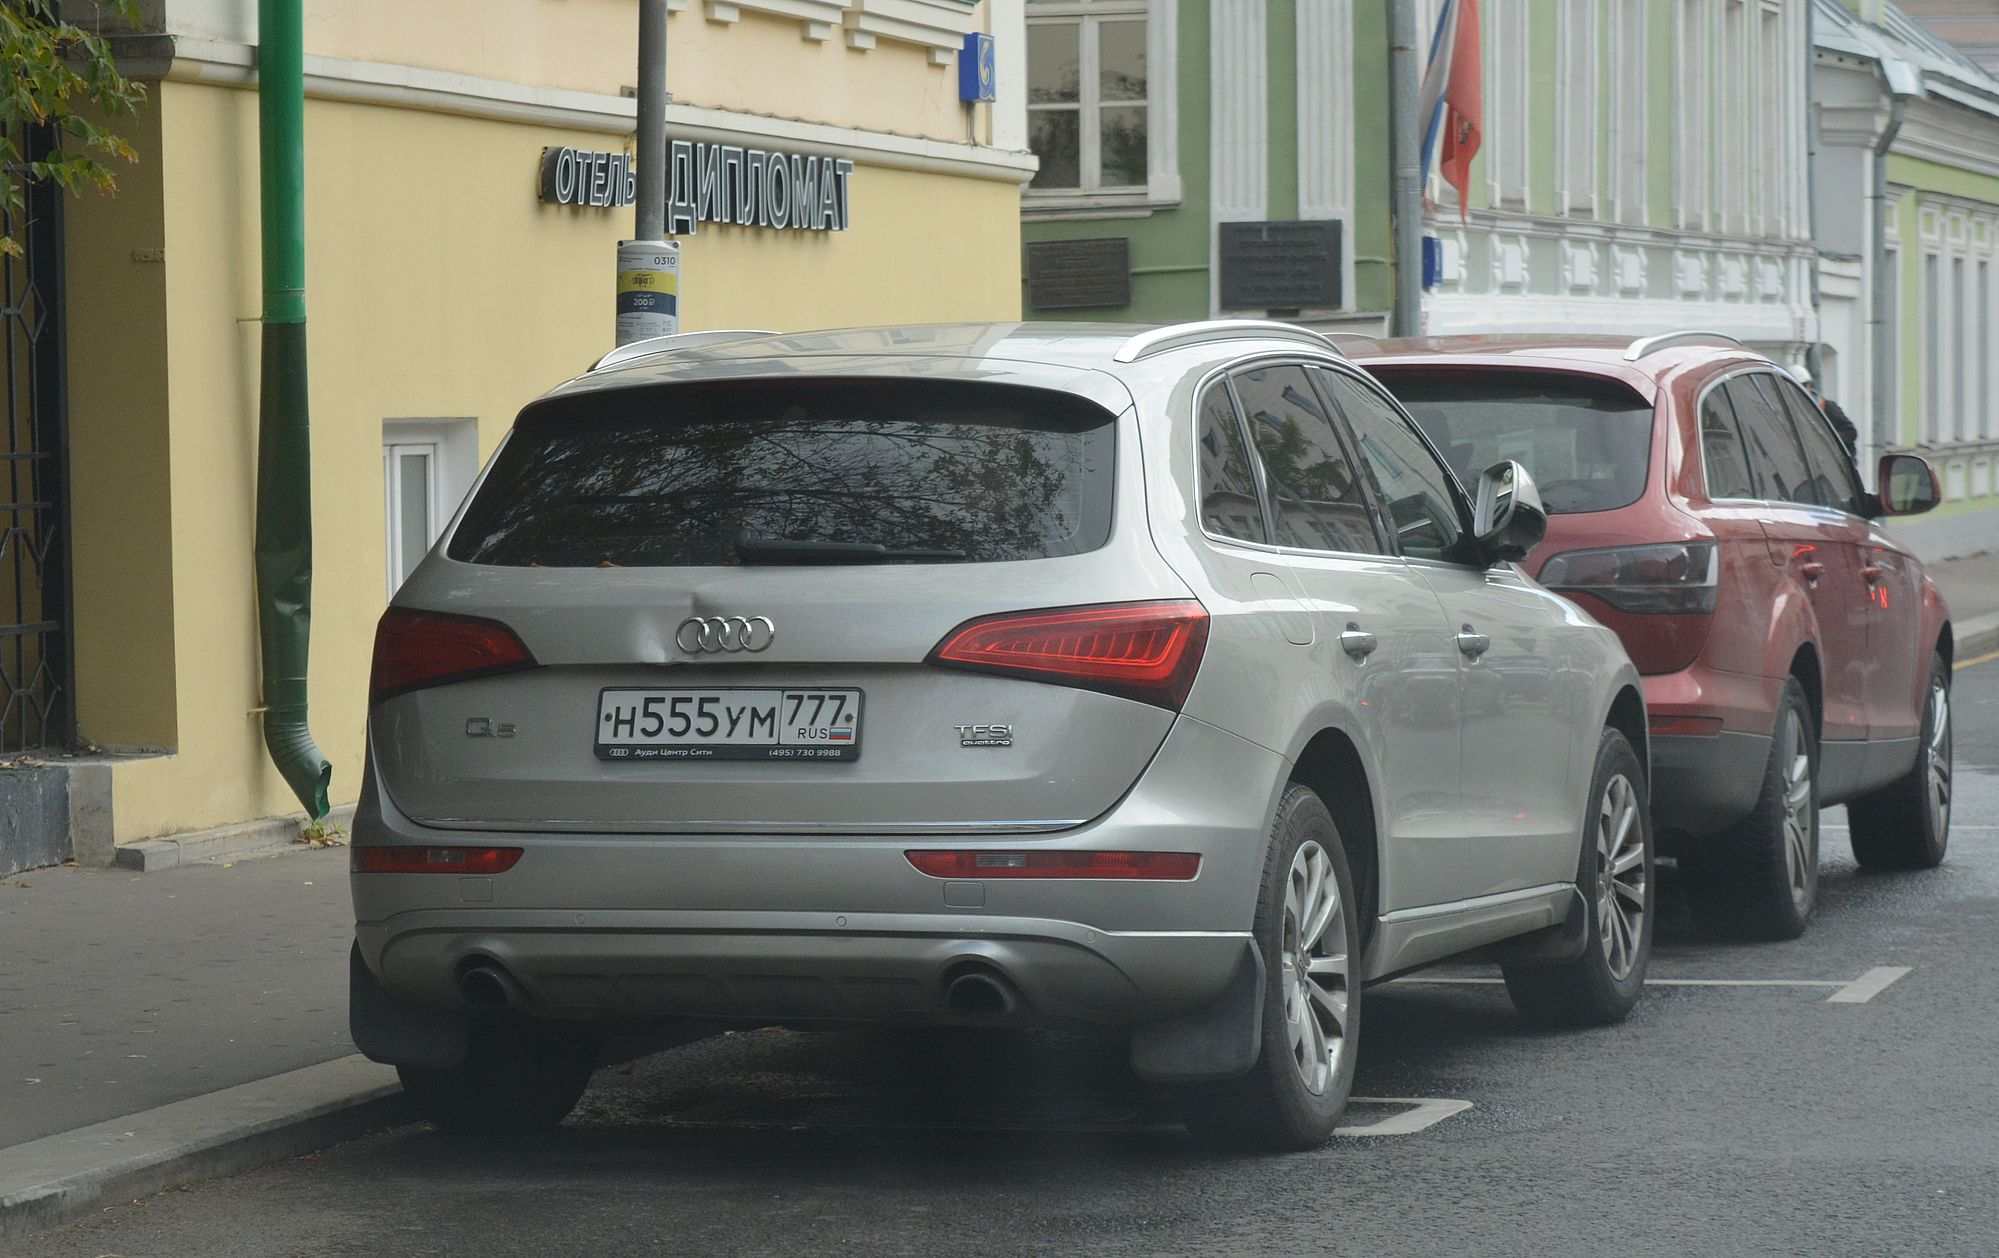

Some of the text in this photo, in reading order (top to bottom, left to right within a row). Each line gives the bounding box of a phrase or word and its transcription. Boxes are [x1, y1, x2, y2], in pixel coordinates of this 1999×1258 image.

[555, 140, 854, 236] ОТЕЛЬ ДИПЛОМАТ
[654, 256, 676, 265] 0310
[785, 694, 848, 727] 777
[465, 717, 517, 739] Q5
[797, 727, 828, 740] RUS
[953, 724, 1013, 738] TFSI
[634, 748, 842, 757] Ауди Центр Сити (495) 730 9988
